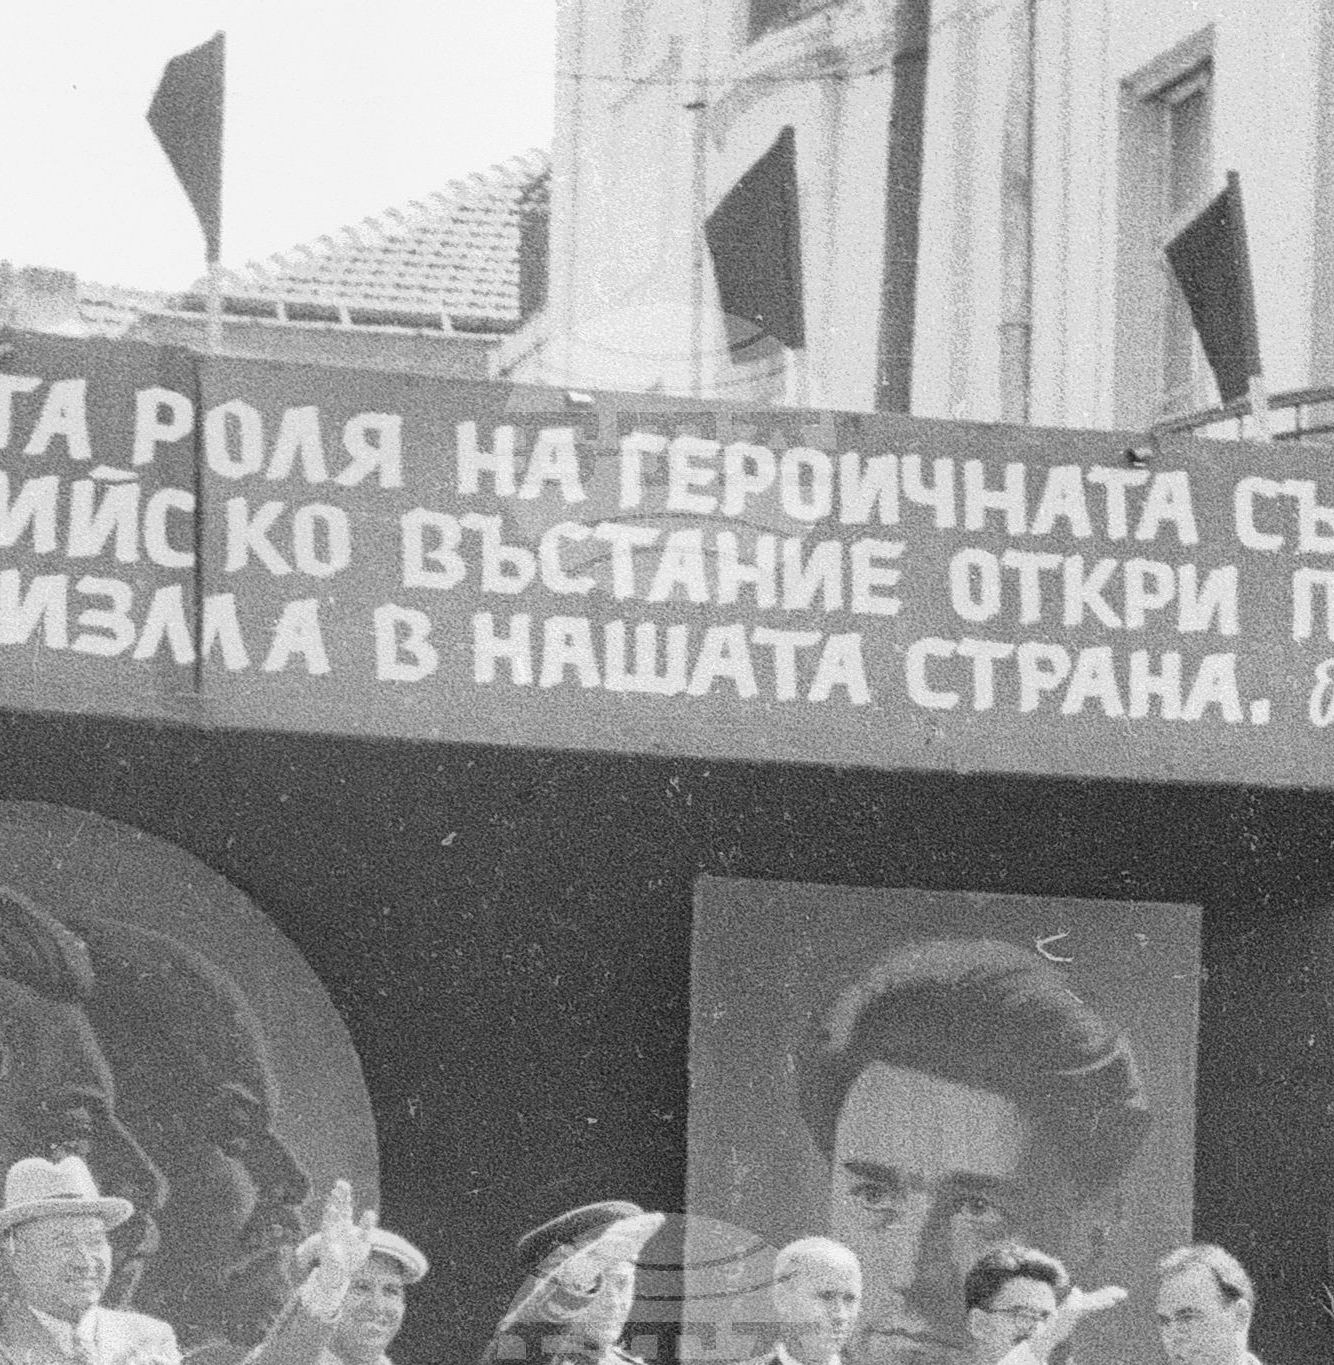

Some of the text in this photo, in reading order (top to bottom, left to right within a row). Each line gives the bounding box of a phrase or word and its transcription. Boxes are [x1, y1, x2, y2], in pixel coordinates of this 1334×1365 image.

[132, 386, 403, 488] РОЛЯ
[457, 419, 587, 502] НА
[620, 431, 1198, 545] ГЕРОИЧНАТА
[400, 506, 905, 617] ВЪСТАНИЕ
[948, 547, 1240, 637] ОТКРИ
[372, 602, 440, 683] В
[472, 610, 872, 706] НАШАТА
[904, 636, 1271, 726] СТРАНА.
